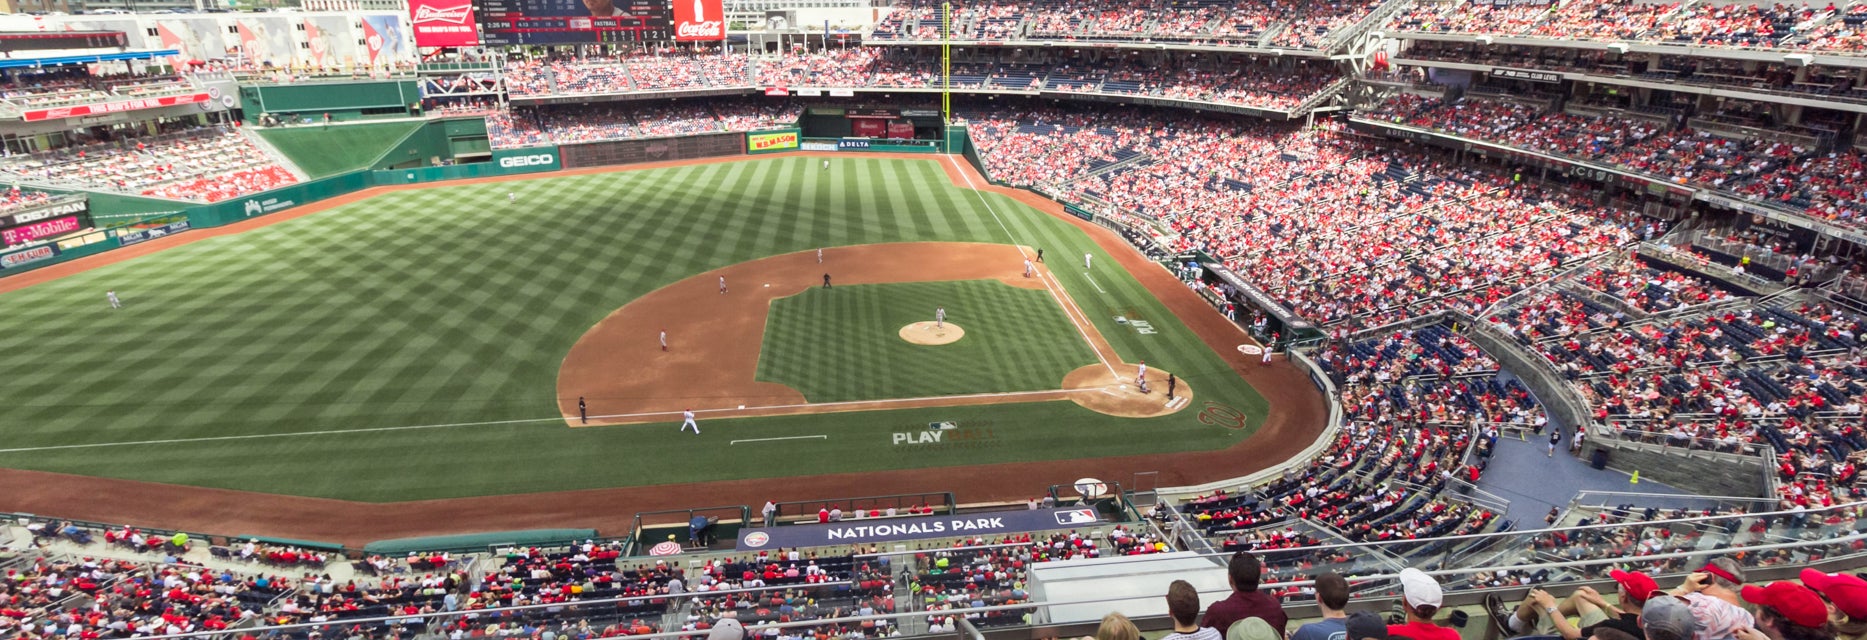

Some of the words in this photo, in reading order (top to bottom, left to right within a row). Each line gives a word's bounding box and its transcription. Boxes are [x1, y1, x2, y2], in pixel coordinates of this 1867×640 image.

[416, 9, 466, 18] Budweiser
[652, 31, 658, 39] 2
[678, 21, 721, 37] Coca-Cola
[500, 154, 553, 168] GEICO
[52, 201, 87, 216] FAN
[893, 430, 943, 445] PLAY
[828, 521, 945, 540] NATIONALS
[952, 517, 1005, 531] PARK
